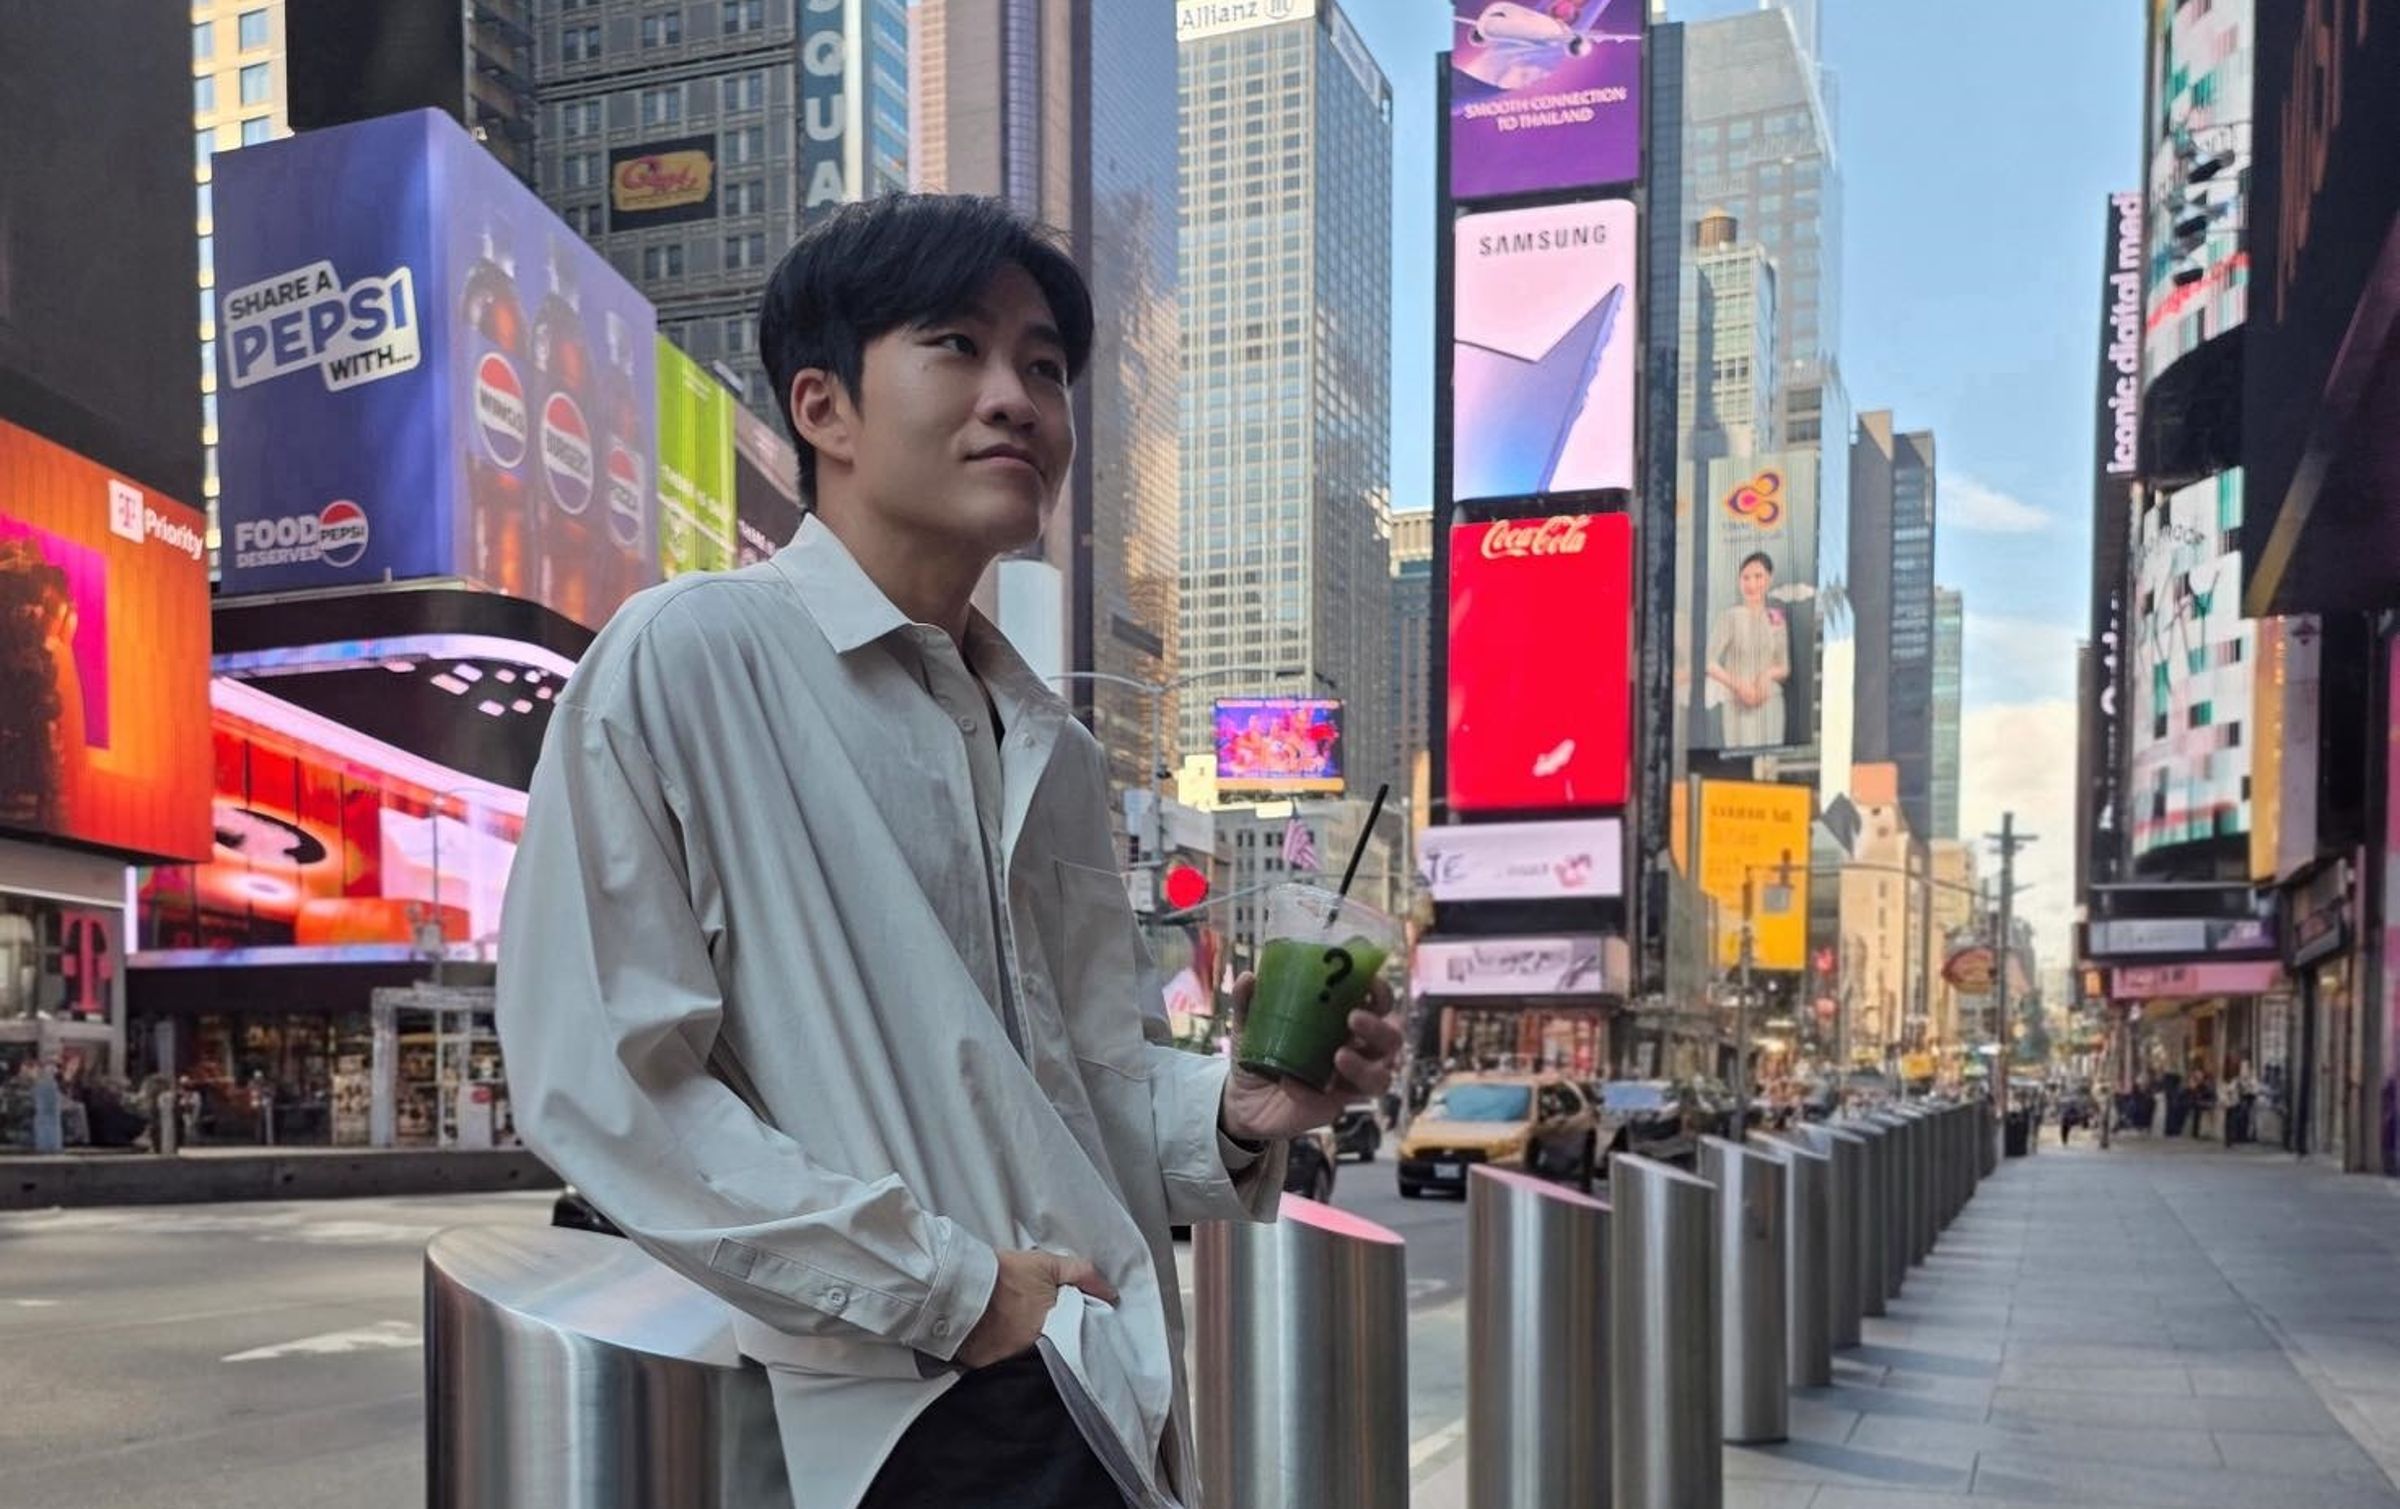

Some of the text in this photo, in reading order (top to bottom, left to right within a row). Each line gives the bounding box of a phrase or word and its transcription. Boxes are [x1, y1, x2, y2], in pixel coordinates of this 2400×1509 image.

[1181, 0, 1259, 30] Allianz
[803, 0, 845, 208] QUA
[1465, 87, 1627, 119] SMOOTH CONNECTION
[1497, 107, 1594, 131] TO THAILAND
[1479, 224, 1606, 256] SAMSUNG
[230, 270, 333, 320] SHARE A
[232, 279, 408, 379] PEPSI
[144, 507, 204, 560] Priority
[235, 515, 320, 552] FOOD
[236, 545, 322, 569] DESERVES
